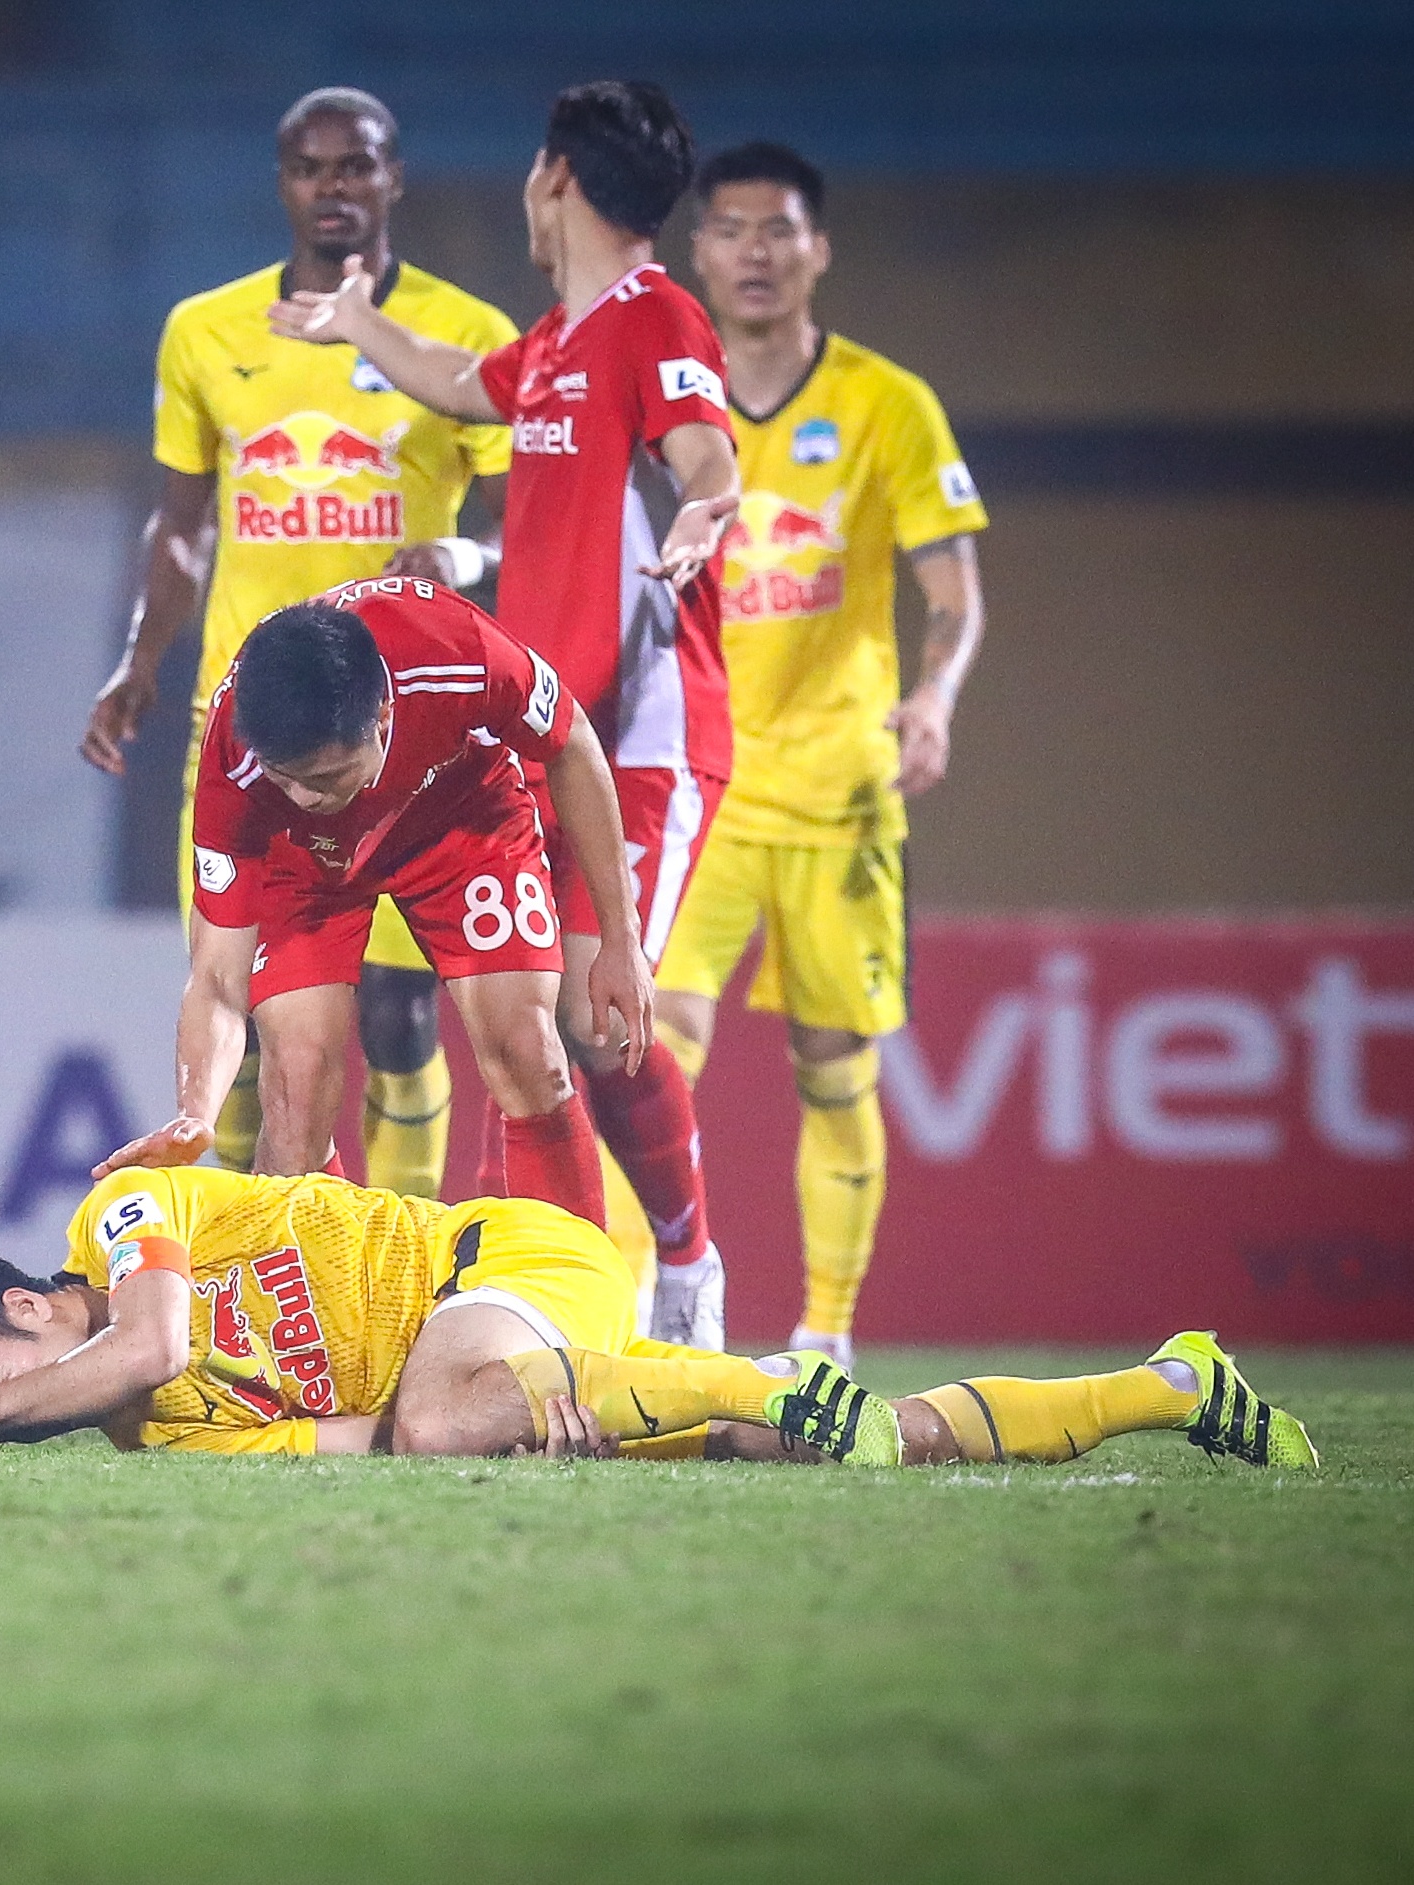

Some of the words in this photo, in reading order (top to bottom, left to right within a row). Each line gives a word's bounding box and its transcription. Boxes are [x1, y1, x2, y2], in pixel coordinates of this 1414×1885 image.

[235, 494, 309, 539] Red
[315, 493, 402, 538] Bull
[333, 577, 435, 610] B.DUY
[462, 871, 556, 951] 88
[103, 1201, 144, 1241] LS
[251, 1246, 324, 1352] Bull
